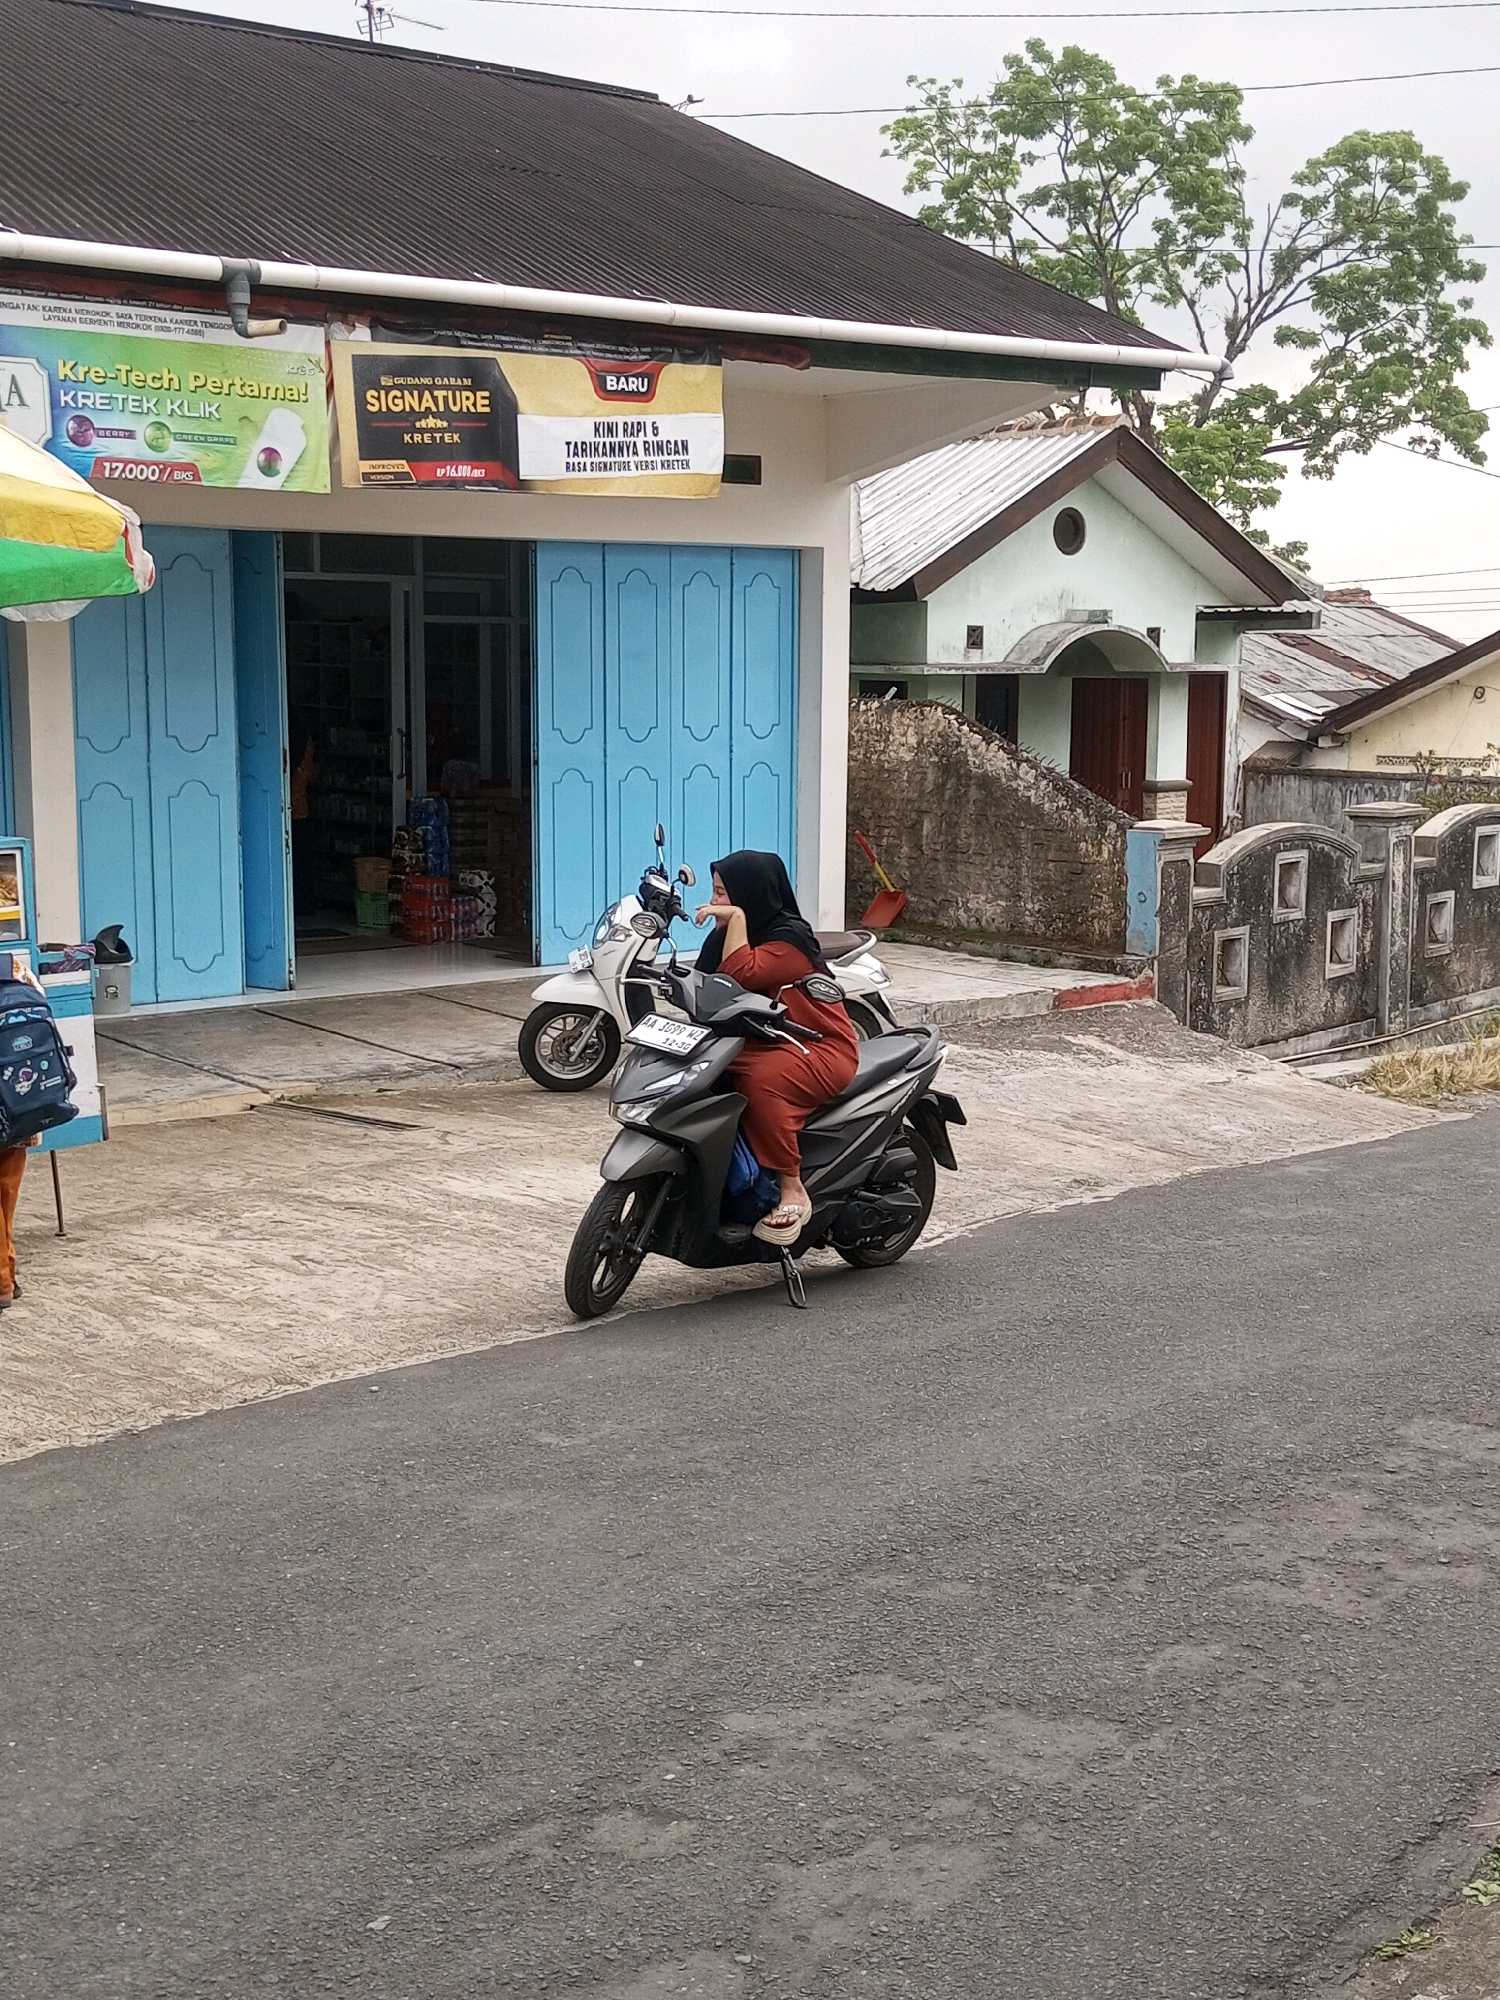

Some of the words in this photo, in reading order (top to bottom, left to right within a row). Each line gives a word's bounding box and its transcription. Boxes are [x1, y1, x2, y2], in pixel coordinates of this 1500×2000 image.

[42, 305, 73, 315] KARENA
[115, 311, 133, 320] SAYA
[134, 313, 168, 324] TERKENA
[169, 317, 199, 328] KANKER
[42, 313, 78, 324] LAYANAN
[79, 316, 115, 328] BERHENTI
[116, 321, 153, 331] MEROKOK
[57, 358, 181, 392] Kre-Tech
[188, 370, 309, 403] Pertama!
[393, 376, 433, 386] GUDANG
[434, 376, 473, 387] GARAM
[605, 374, 649, 393] BARU
[0, 373, 31, 412] A
[365, 389, 492, 413] SIGNATURE
[59, 388, 160, 415] KRETEK
[166, 398, 222, 420] KLIK
[99, 428, 131, 438] BERRY
[403, 432, 462, 444] KRETEK
[593, 421, 619, 439] KINI
[622, 421, 648, 438] RAPI
[651, 420, 660, 438] &
[175, 433, 206, 442] GREEN
[206, 436, 236, 445] GRAPE
[565, 440, 640, 459] TARIKANNYA
[642, 439, 690, 458] RINGAN
[368, 462, 406, 471] IMPROVED
[565, 460, 588, 474] RASA
[589, 460, 633, 473] SIGNATURE
[633, 460, 659, 472] VERSI
[660, 458, 691, 471] KRETEK
[173, 469, 195, 482] BKS
[641, 1016, 658, 1029] AA
